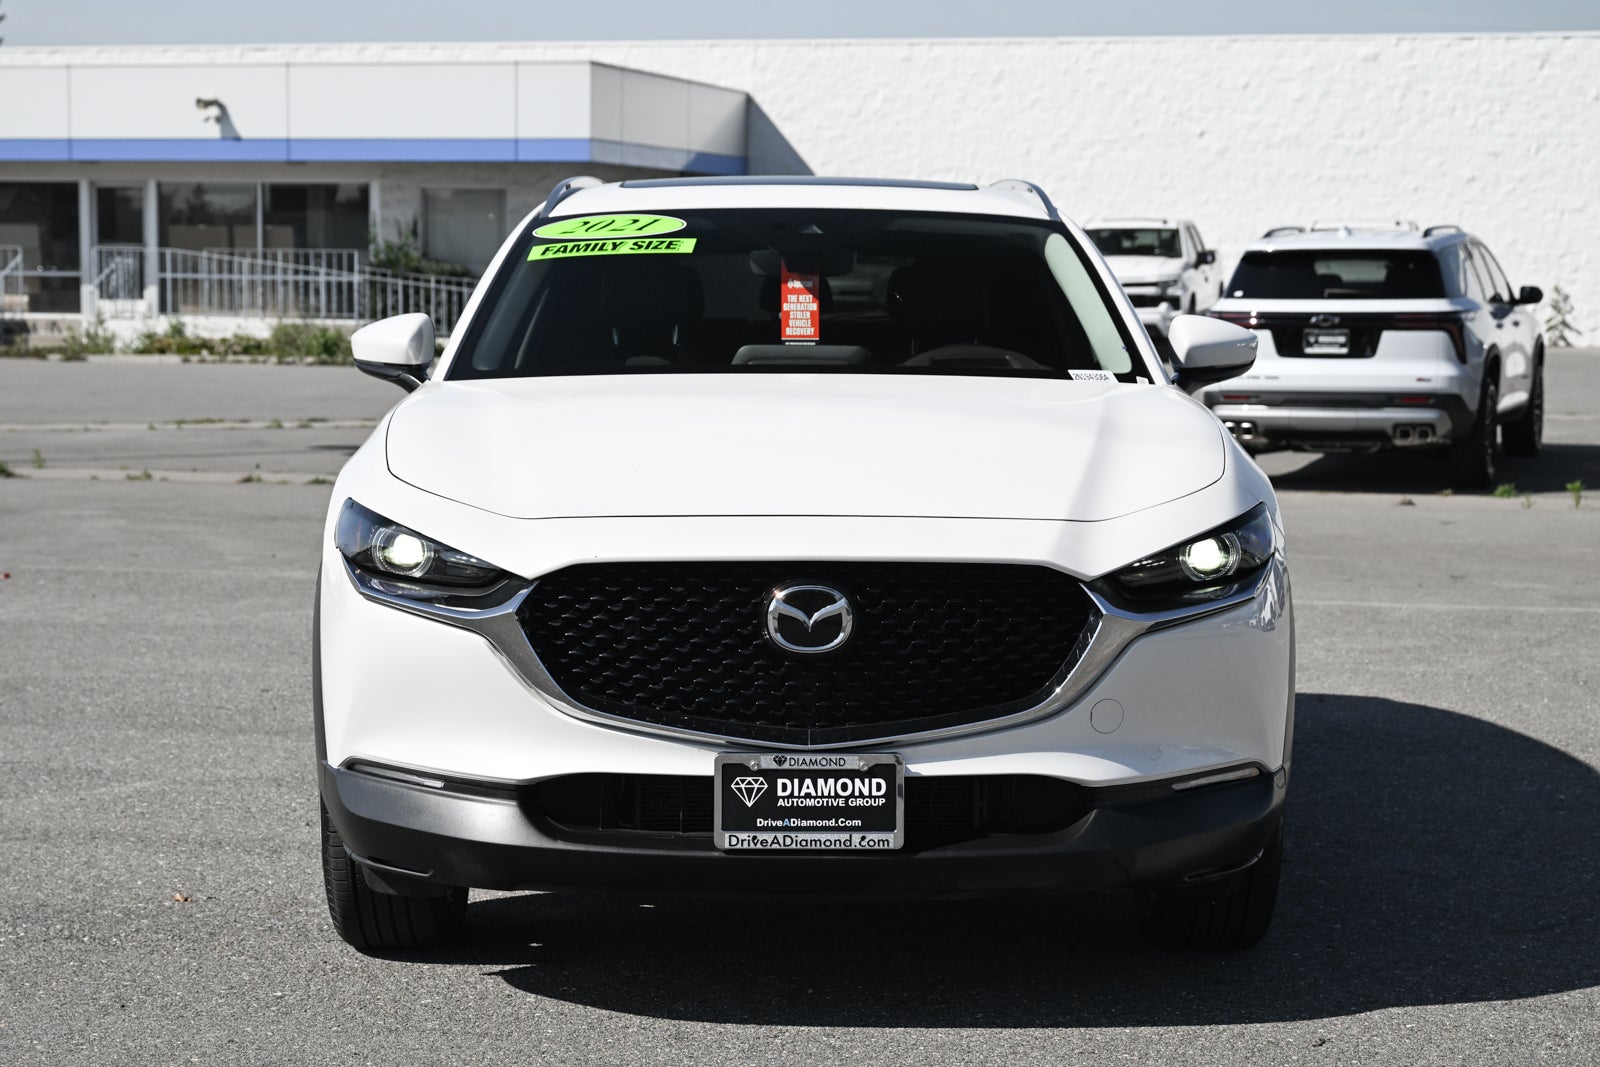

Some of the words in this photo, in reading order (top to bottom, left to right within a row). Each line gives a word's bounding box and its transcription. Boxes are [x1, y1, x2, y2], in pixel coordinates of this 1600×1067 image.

[557, 218, 663, 235] 2021
[540, 240, 624, 256] FAMILY
[629, 240, 682, 251] SIZE
[787, 294, 798, 303] THE
[799, 294, 813, 303] NEXT
[783, 302, 817, 311] GENERATION
[789, 311, 811, 319] STOLEN
[788, 319, 812, 327] VEHICLE
[785, 327, 815, 336] RECOVERY
[788, 757, 846, 767] DIAMOND
[776, 777, 887, 797] DIAMOND
[776, 798, 846, 807] AUTOMOTIVE
[848, 798, 886, 807] GROUP
[756, 818, 862, 827] DriveADiamond.Com
[728, 834, 890, 848] DriveADiamond.com
